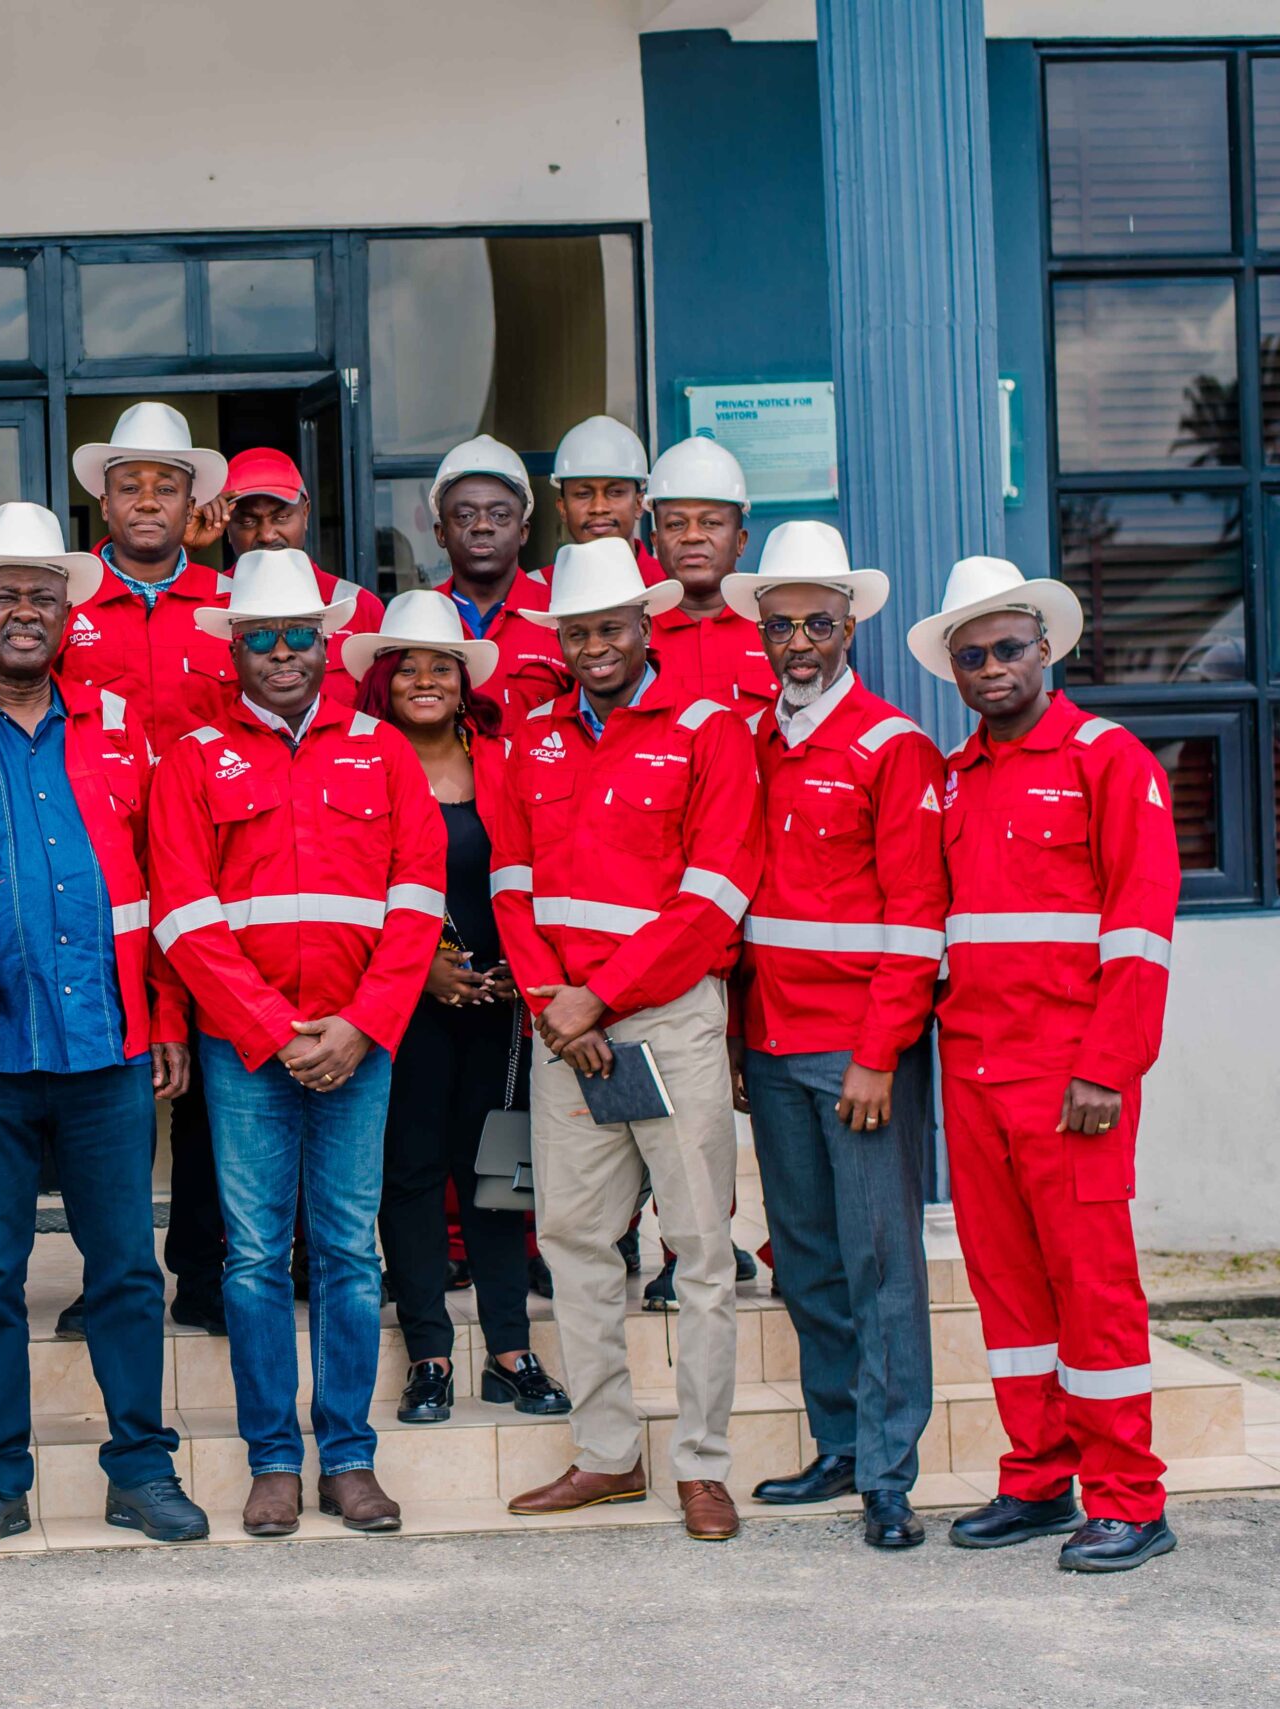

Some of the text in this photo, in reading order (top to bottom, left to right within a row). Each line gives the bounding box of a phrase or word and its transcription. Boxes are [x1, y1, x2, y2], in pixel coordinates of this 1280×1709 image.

[715, 397, 813, 409] PRIVACY NOTICE FOR
[715, 411, 758, 420] VISITORS
[69, 630, 102, 644] aradel
[529, 748, 566, 758] aradel
[215, 761, 252, 779] aradel
